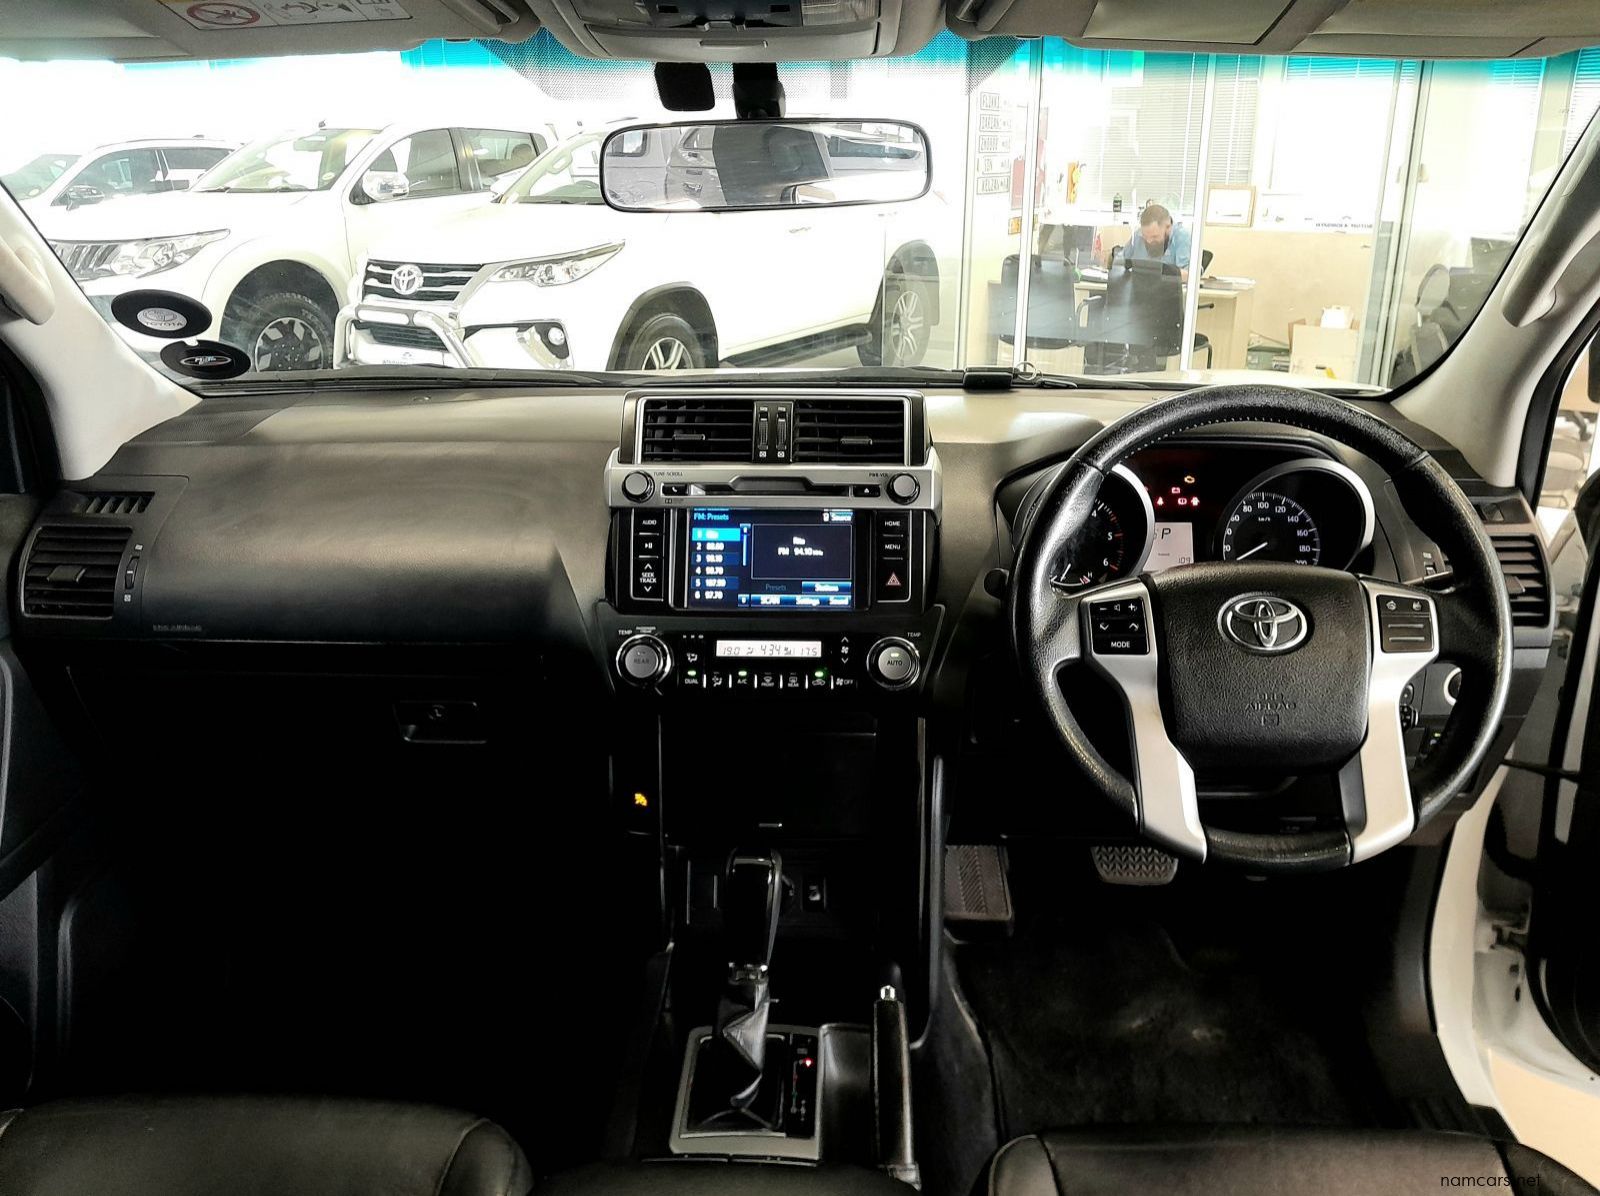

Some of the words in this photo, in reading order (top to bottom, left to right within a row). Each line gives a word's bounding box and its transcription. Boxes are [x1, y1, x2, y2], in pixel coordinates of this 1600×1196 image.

[1242, 505, 1252, 513] 80
[1257, 501, 1269, 509] 100
[707, 512, 729, 521] Presets
[1092, 509, 1097, 518] 4
[1287, 515, 1299, 523] 140
[1107, 531, 1113, 541] 5
[1162, 528, 1171, 540] P
[1297, 529, 1308, 537] 160
[696, 542, 702, 551] 2
[1299, 544, 1311, 552] 180
[696, 554, 702, 563] 3
[1103, 557, 1109, 567] 6
[695, 566, 702, 575] 4
[695, 578, 701, 587] 5
[765, 583, 786, 591] Presets
[1110, 640, 1131, 649] MODE
[886, 659, 903, 667] AUTO
